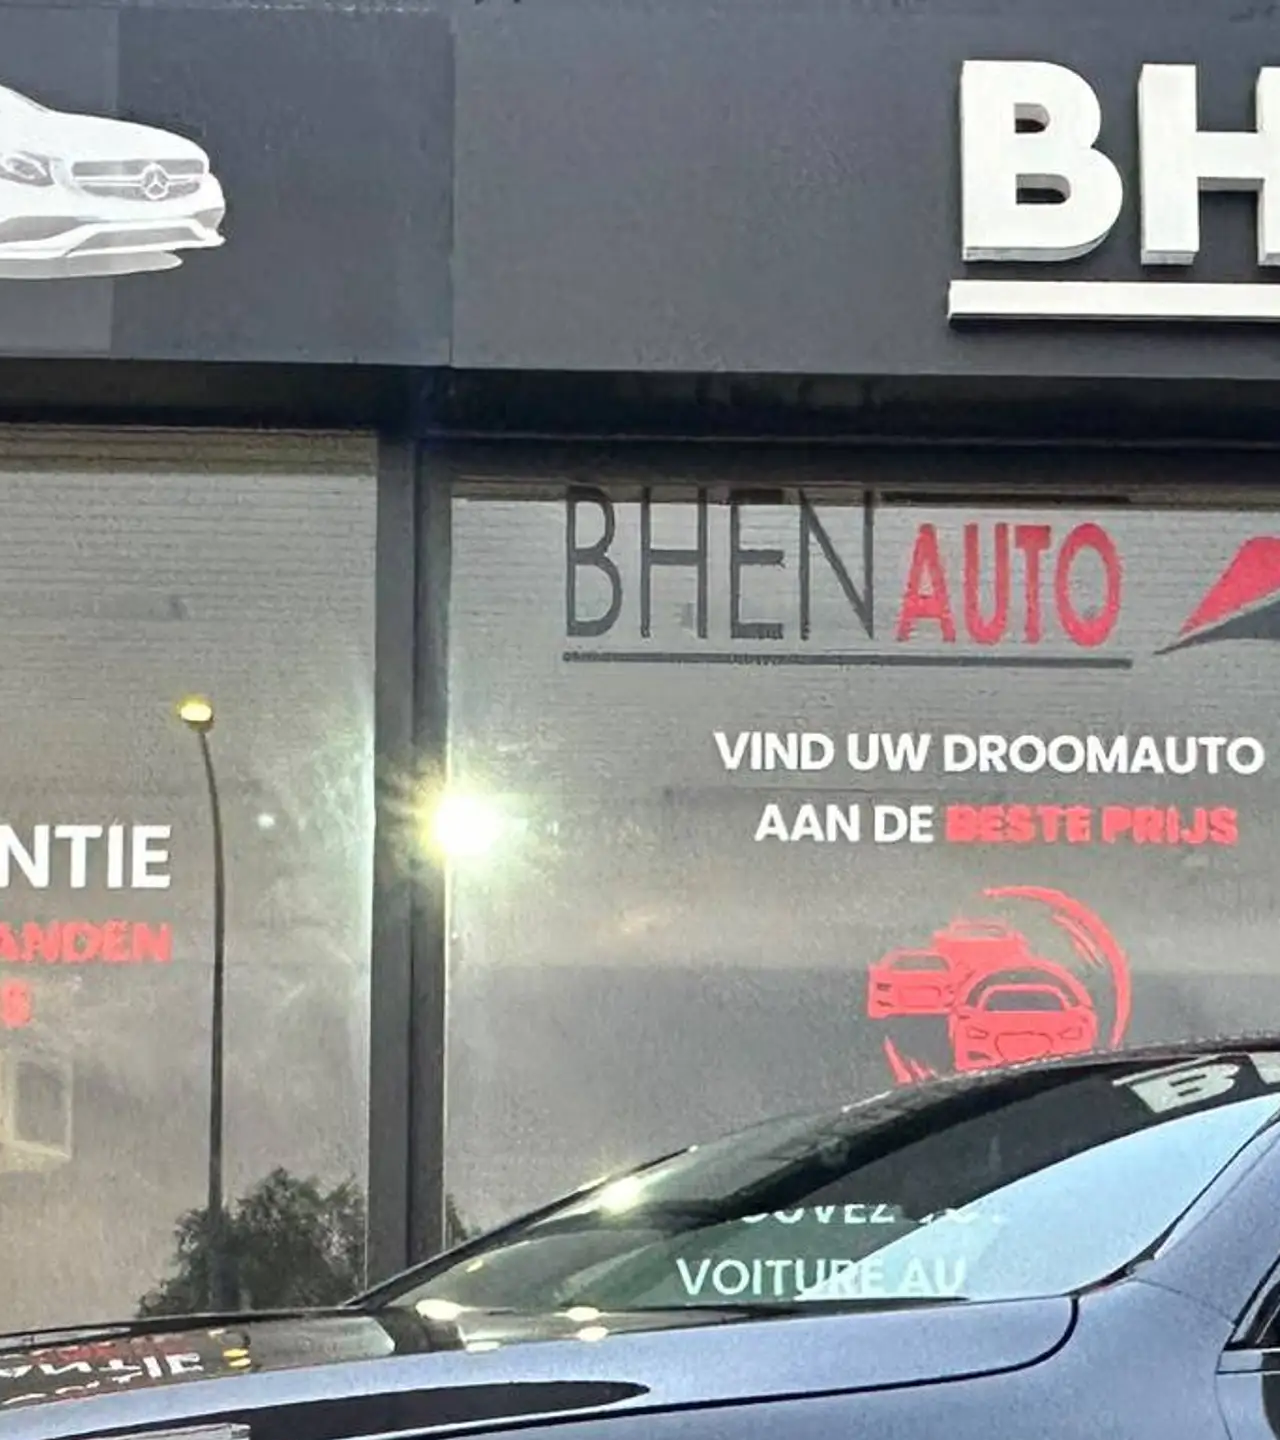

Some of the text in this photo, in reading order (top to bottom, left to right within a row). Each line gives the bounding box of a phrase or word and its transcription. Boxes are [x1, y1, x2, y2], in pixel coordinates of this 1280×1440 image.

[714, 731, 1266, 776] VIND UW DROOMAUTO
[754, 803, 1239, 848] AAN DE BESTE PRIJS
[676, 1256, 967, 1297] VOITURE AU
